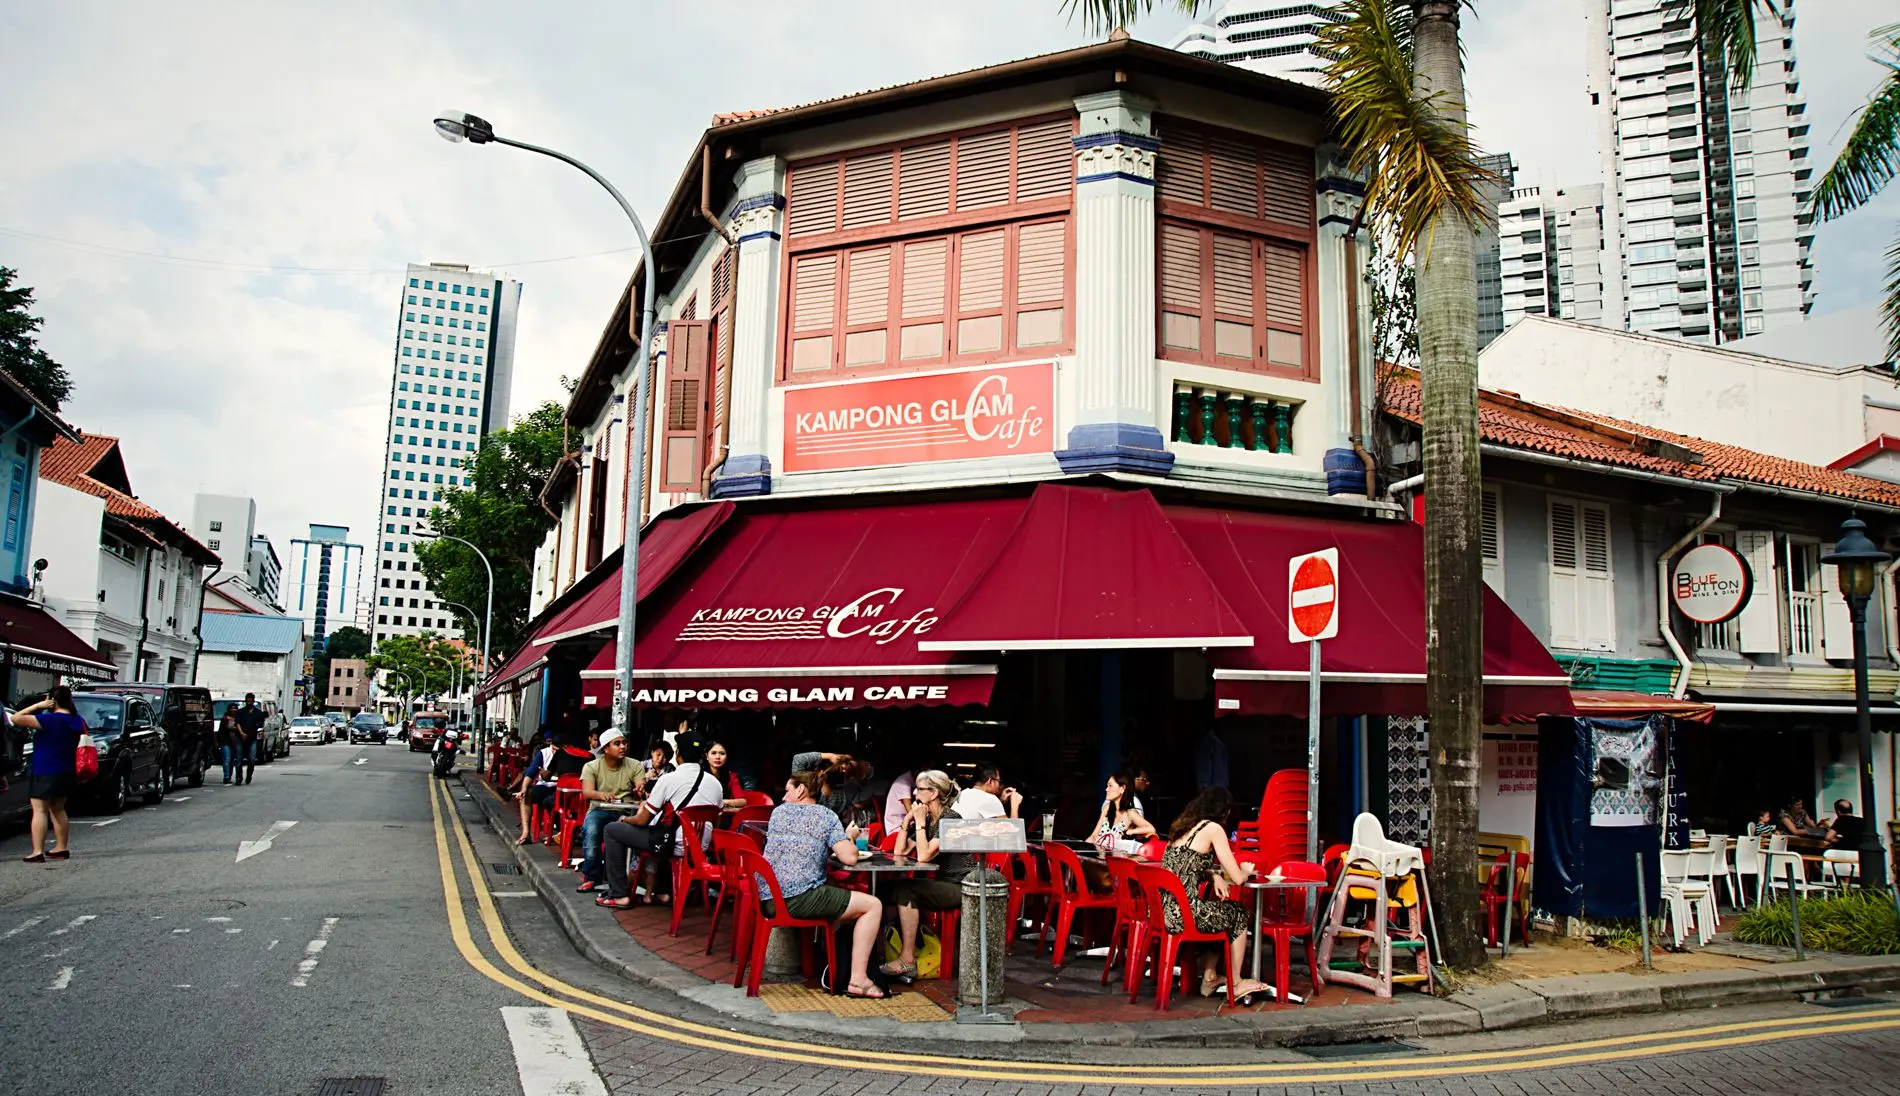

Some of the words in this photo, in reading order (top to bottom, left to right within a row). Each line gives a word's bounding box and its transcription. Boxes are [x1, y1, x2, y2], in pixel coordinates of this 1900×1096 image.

[796, 402, 922, 434] KAMPONG
[930, 393, 1014, 423] GLAM
[964, 375, 1044, 449] Cafe
[691, 607, 805, 622] KAMPONG
[812, 604, 885, 619] GLAM
[827, 587, 939, 645] Cafe
[632, 688, 759, 703] AMPONG
[767, 687, 854, 702] GLAM
[863, 686, 949, 700] CAFE
